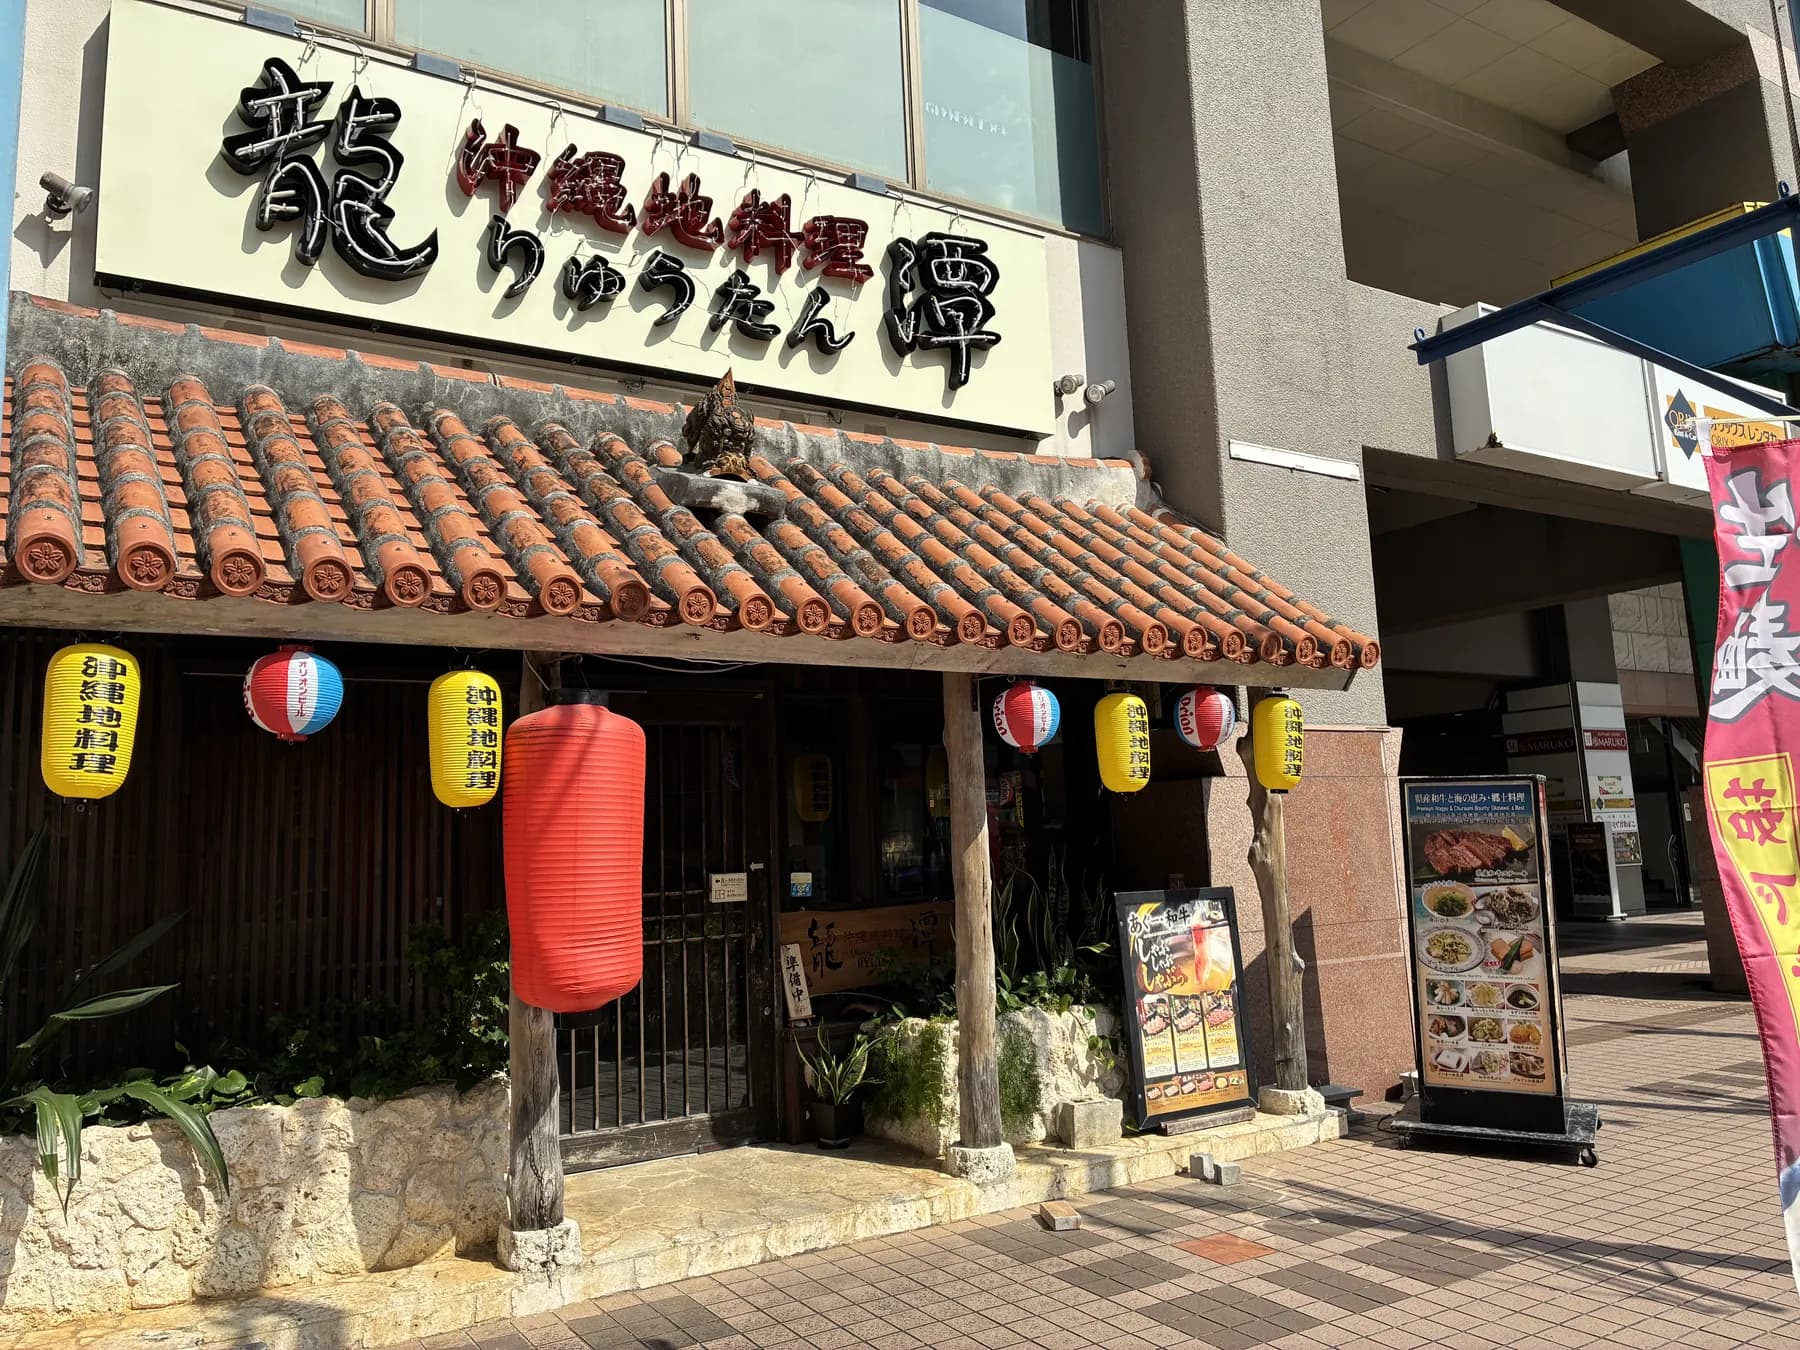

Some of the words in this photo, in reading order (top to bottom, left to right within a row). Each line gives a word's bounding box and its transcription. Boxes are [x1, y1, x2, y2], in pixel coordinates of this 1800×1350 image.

[221, 57, 438, 281] 龍
[456, 118, 873, 284] 沖縄地料理
[487, 214, 855, 355] りゅうたん
[886, 231, 1001, 391] 潭
[68, 655, 128, 775] 沖縄地料理
[295, 660, 308, 718] オリオンビール
[465, 685, 498, 789] 沖縄地料理
[994, 694, 1008, 736] Orion
[1180, 696, 1194, 736] Orion
[785, 955, 805, 1002] 準備中
